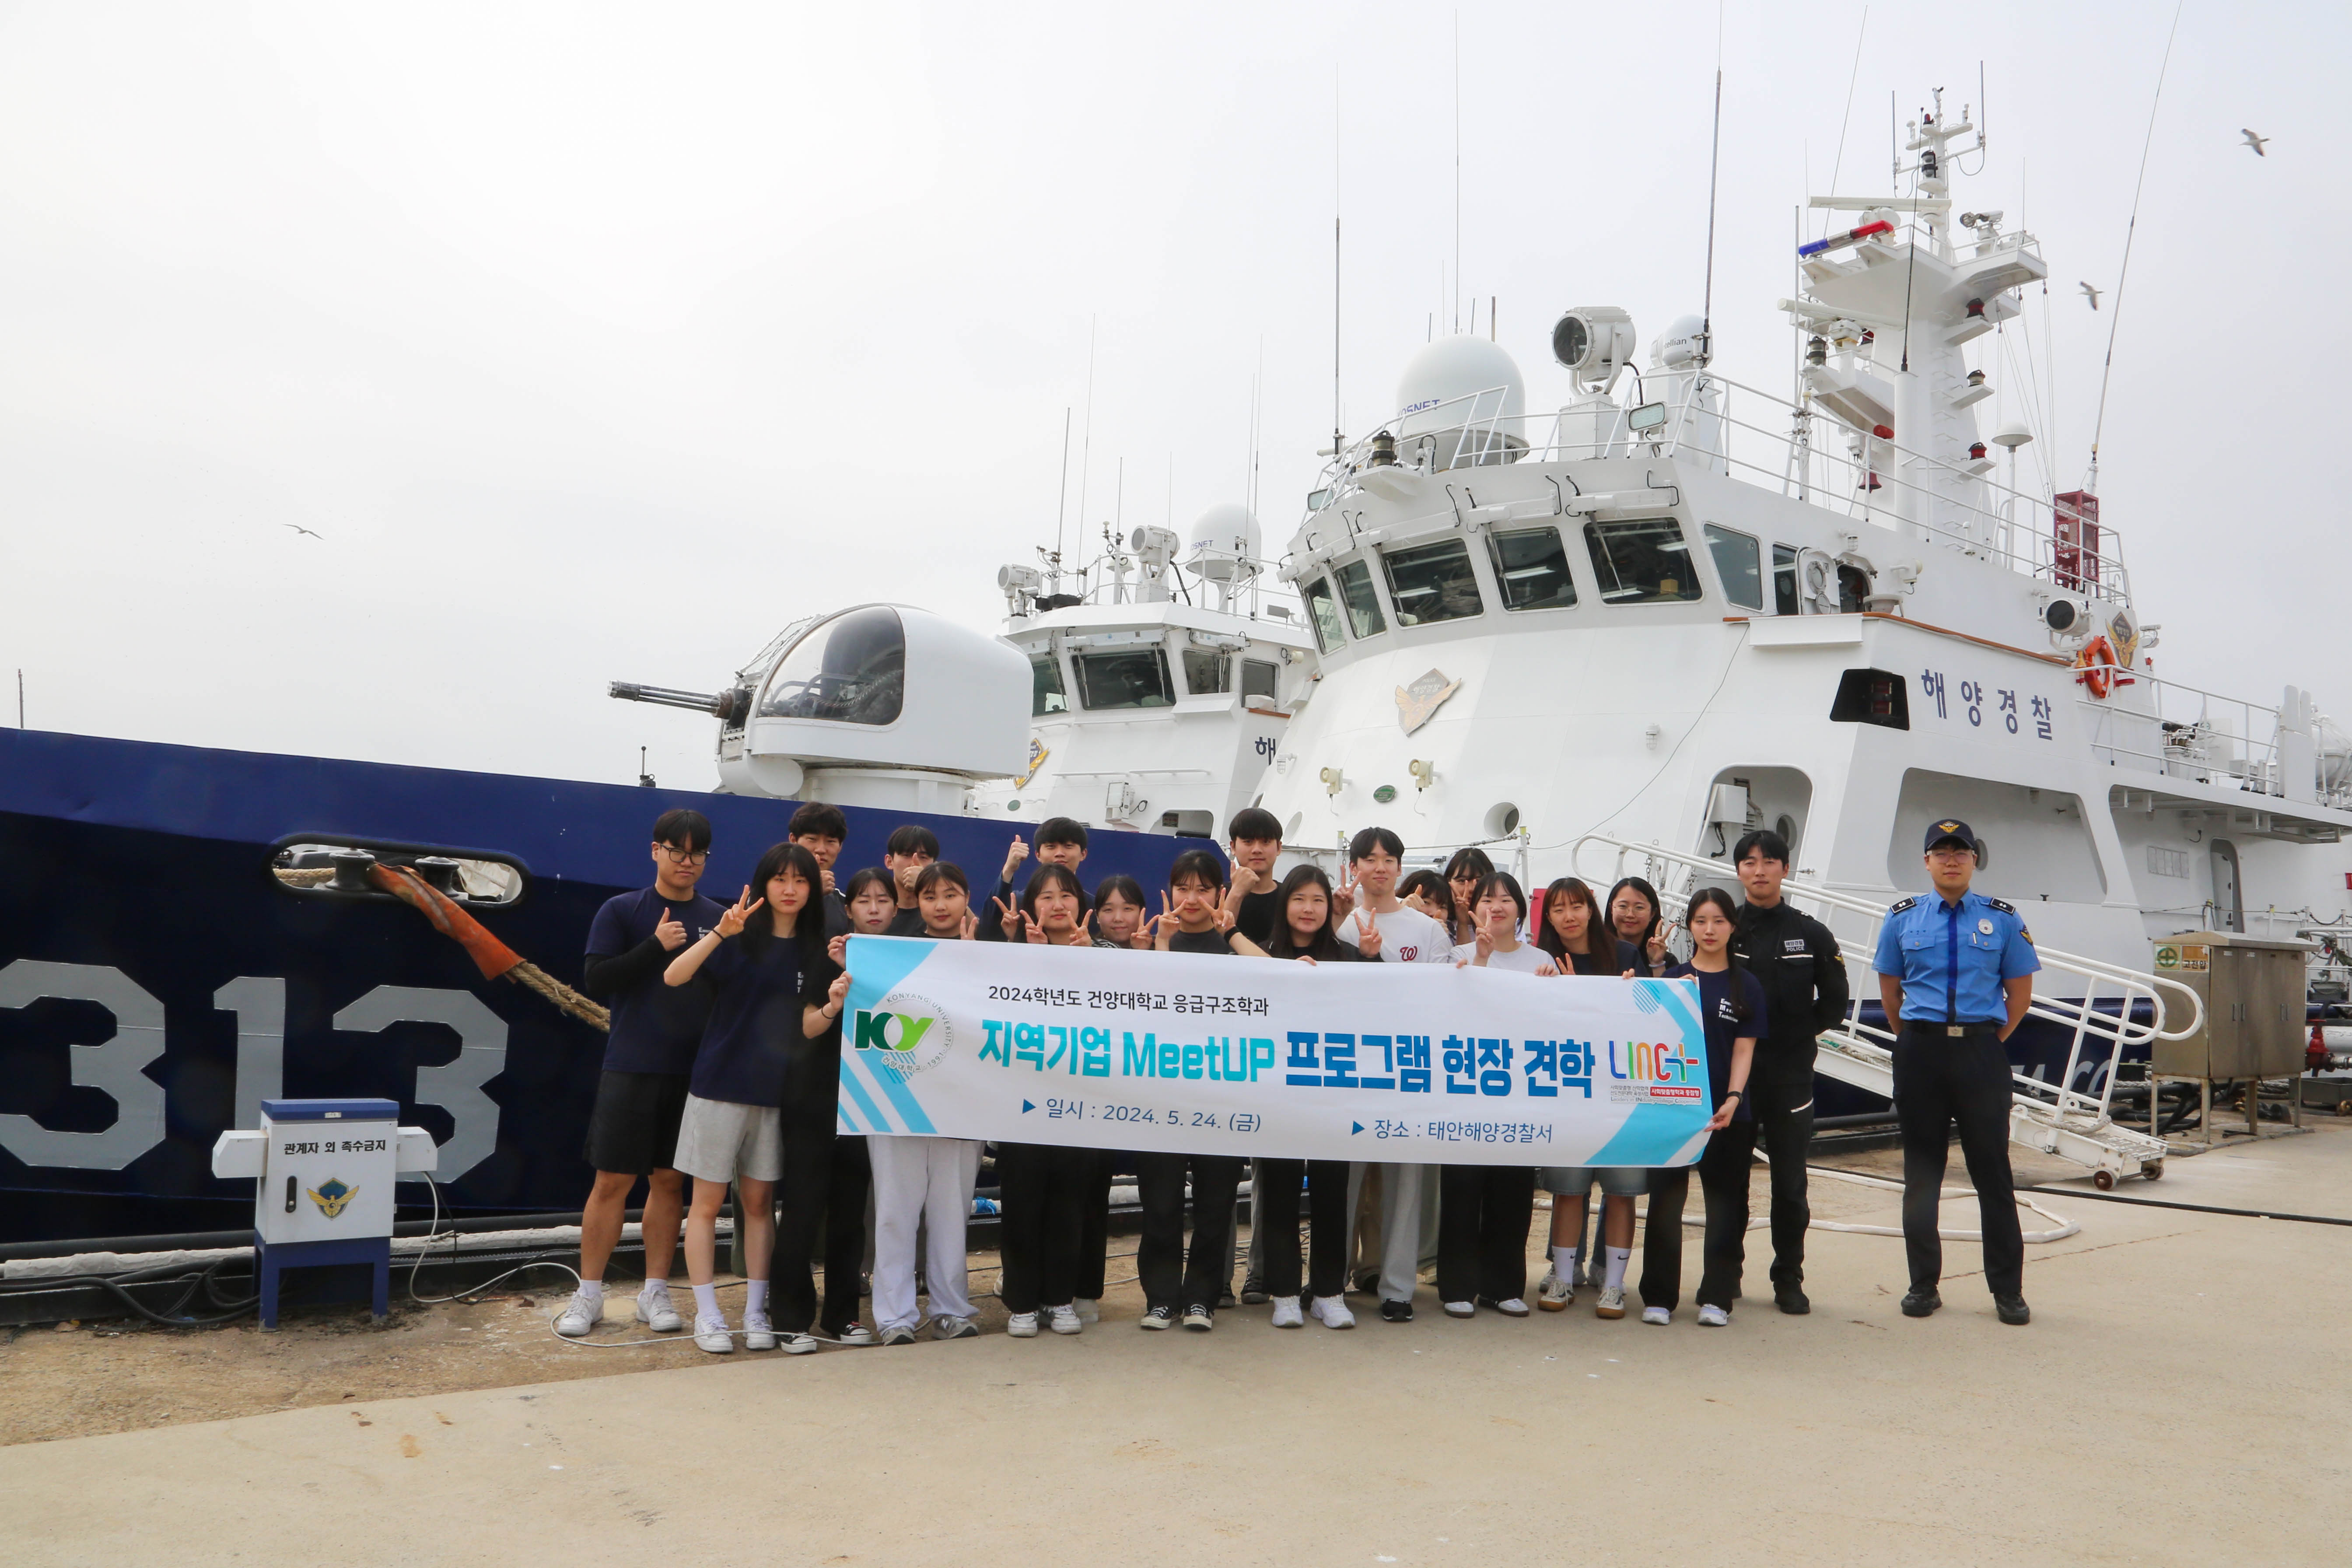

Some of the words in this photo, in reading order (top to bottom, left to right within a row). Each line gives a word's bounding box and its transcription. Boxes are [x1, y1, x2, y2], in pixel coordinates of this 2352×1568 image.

[1921, 669, 2052, 741] 해양경찰
[1255, 736, 1276, 766] 해
[2183, 959, 2206, 970] 고전압
[989, 986, 1082, 1006] 2024학년도
[1088, 990, 1168, 1011] 건양대학교
[1173, 994, 1269, 1016] 응급구조학과
[886, 992, 931, 1004] KONYANG
[932, 1002, 952, 1049] UNIVERSITY
[0, 958, 508, 1184] 313
[978, 1019, 1111, 1078] 지역기업
[1123, 1032, 1275, 1082] MeetUP
[1286, 1031, 1431, 1093] 프로그램
[1442, 1034, 1513, 1096] 현장
[1523, 1039, 1596, 1098] 견학
[1046, 1099, 1083, 1120] 일시
[1102, 1105, 1159, 1124] 2024.
[1167, 1110, 1183, 1126] 5.
[1191, 1112, 1221, 1129] 24.
[1229, 1113, 1261, 1133] (금)
[1374, 1119, 1409, 1139] 장소
[1428, 1121, 1552, 1144] 태안해양경찰서
[284, 1141, 319, 1155] 관계자
[324, 1141, 335, 1153] 외
[341, 1140, 386, 1152] 촉수금지
